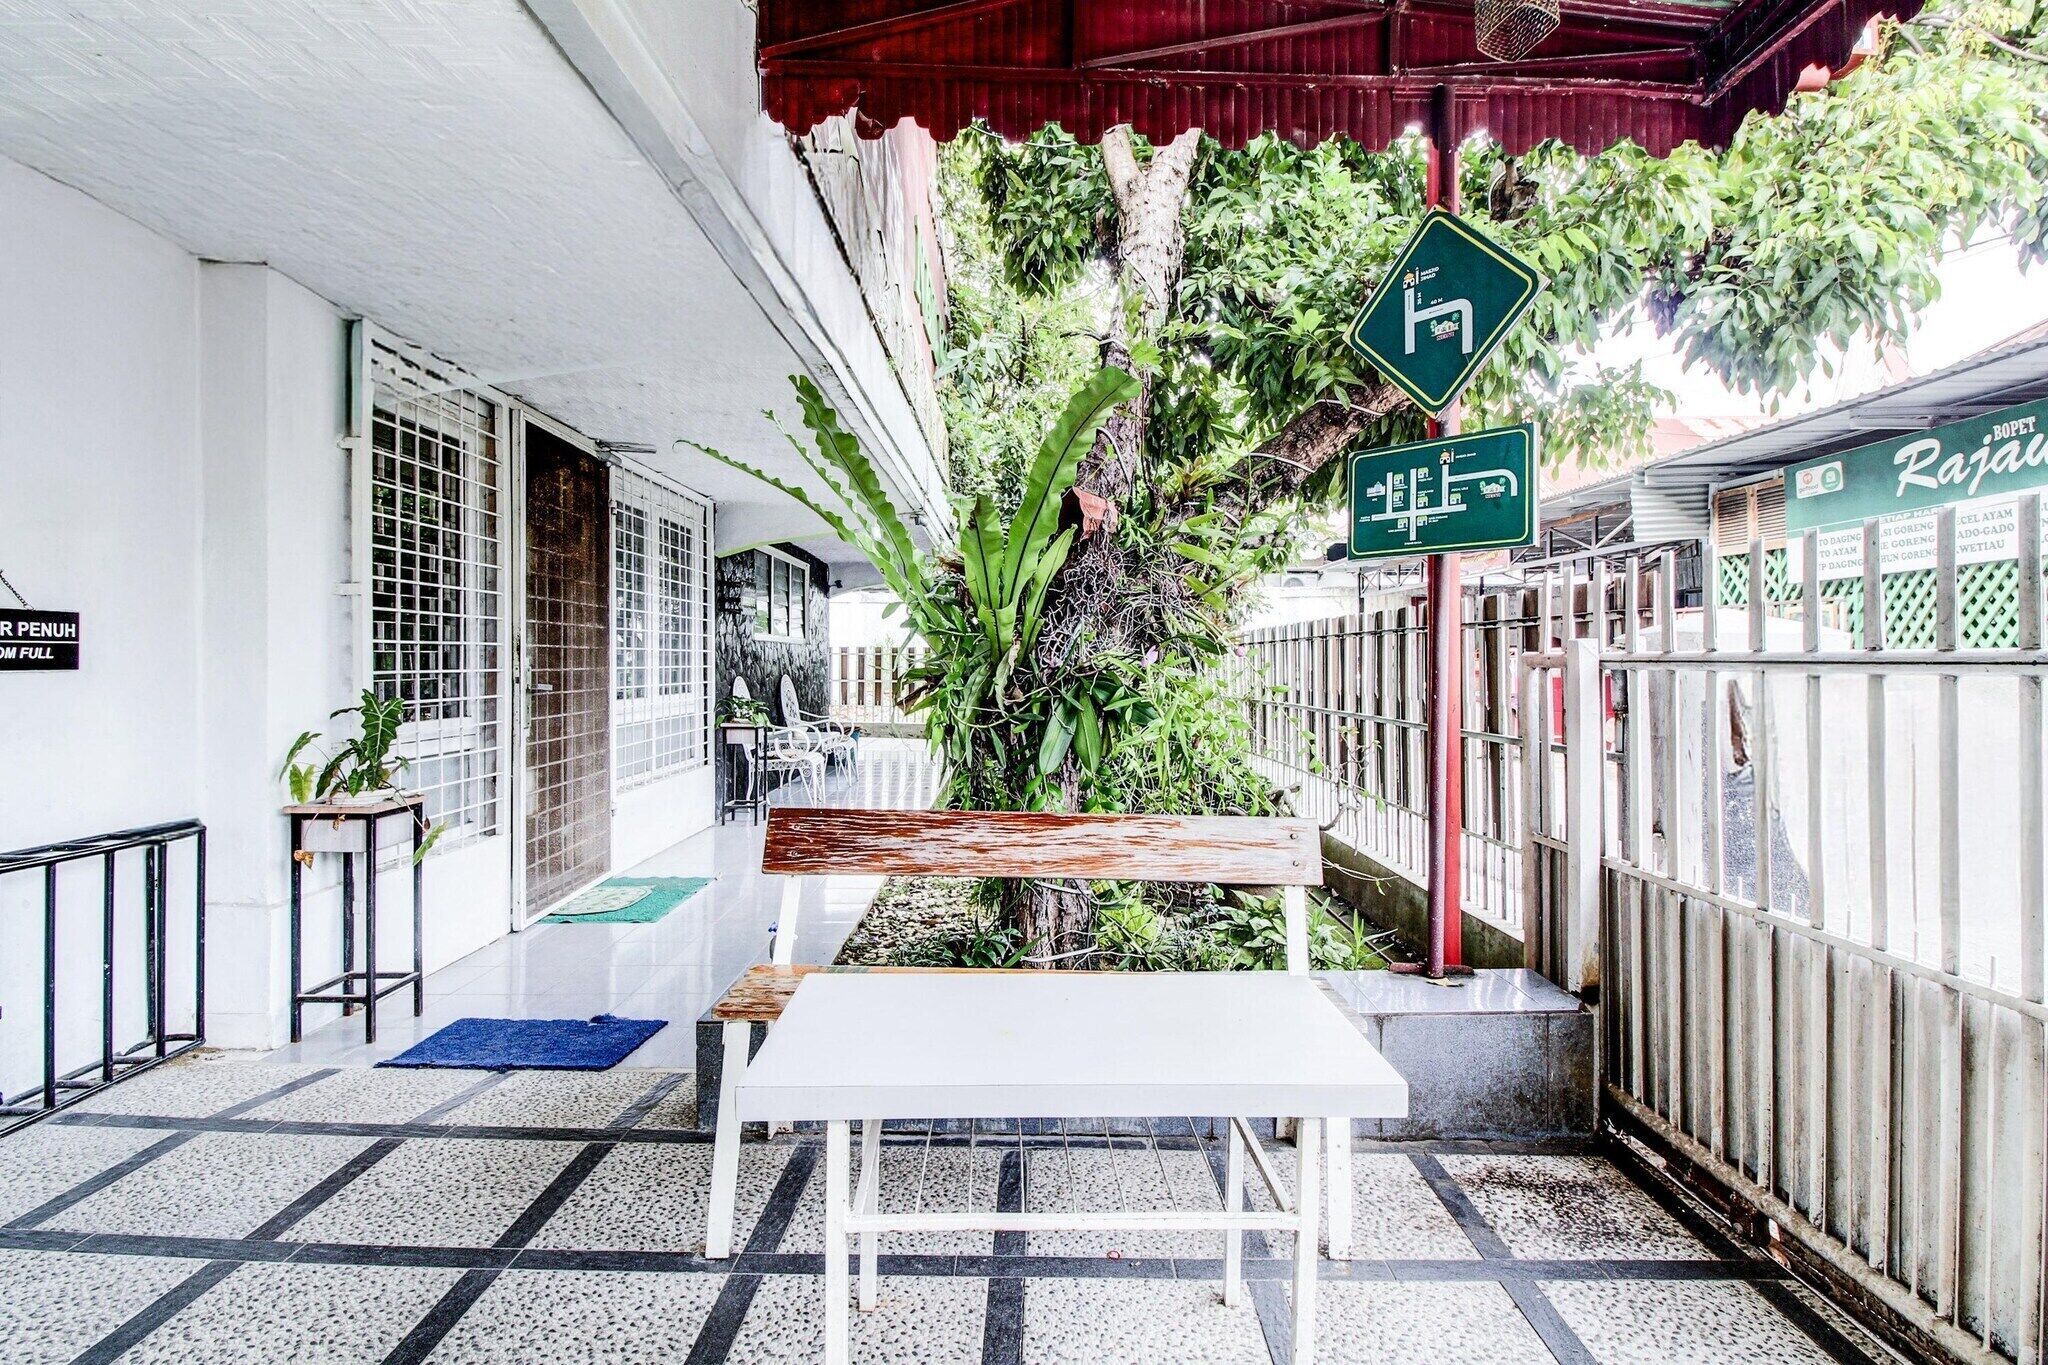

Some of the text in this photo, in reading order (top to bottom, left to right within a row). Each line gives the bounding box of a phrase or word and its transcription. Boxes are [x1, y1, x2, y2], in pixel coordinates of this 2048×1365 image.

[1993, 416, 2036, 441] BOPET
[1982, 508, 2013, 522] AYAM
[1893, 521, 1934, 536] GORENG
[1957, 522, 2015, 540] ADO-GADO
[1830, 533, 1862, 545] DAGING
[1891, 534, 1936, 548] GORENG
[1832, 546, 1857, 556] AYAM
[1901, 548, 1938, 561] GORENG
[1828, 558, 1864, 570] DAGING
[17, 621, 76, 638] PENUH
[19, 647, 54, 660] FULL
